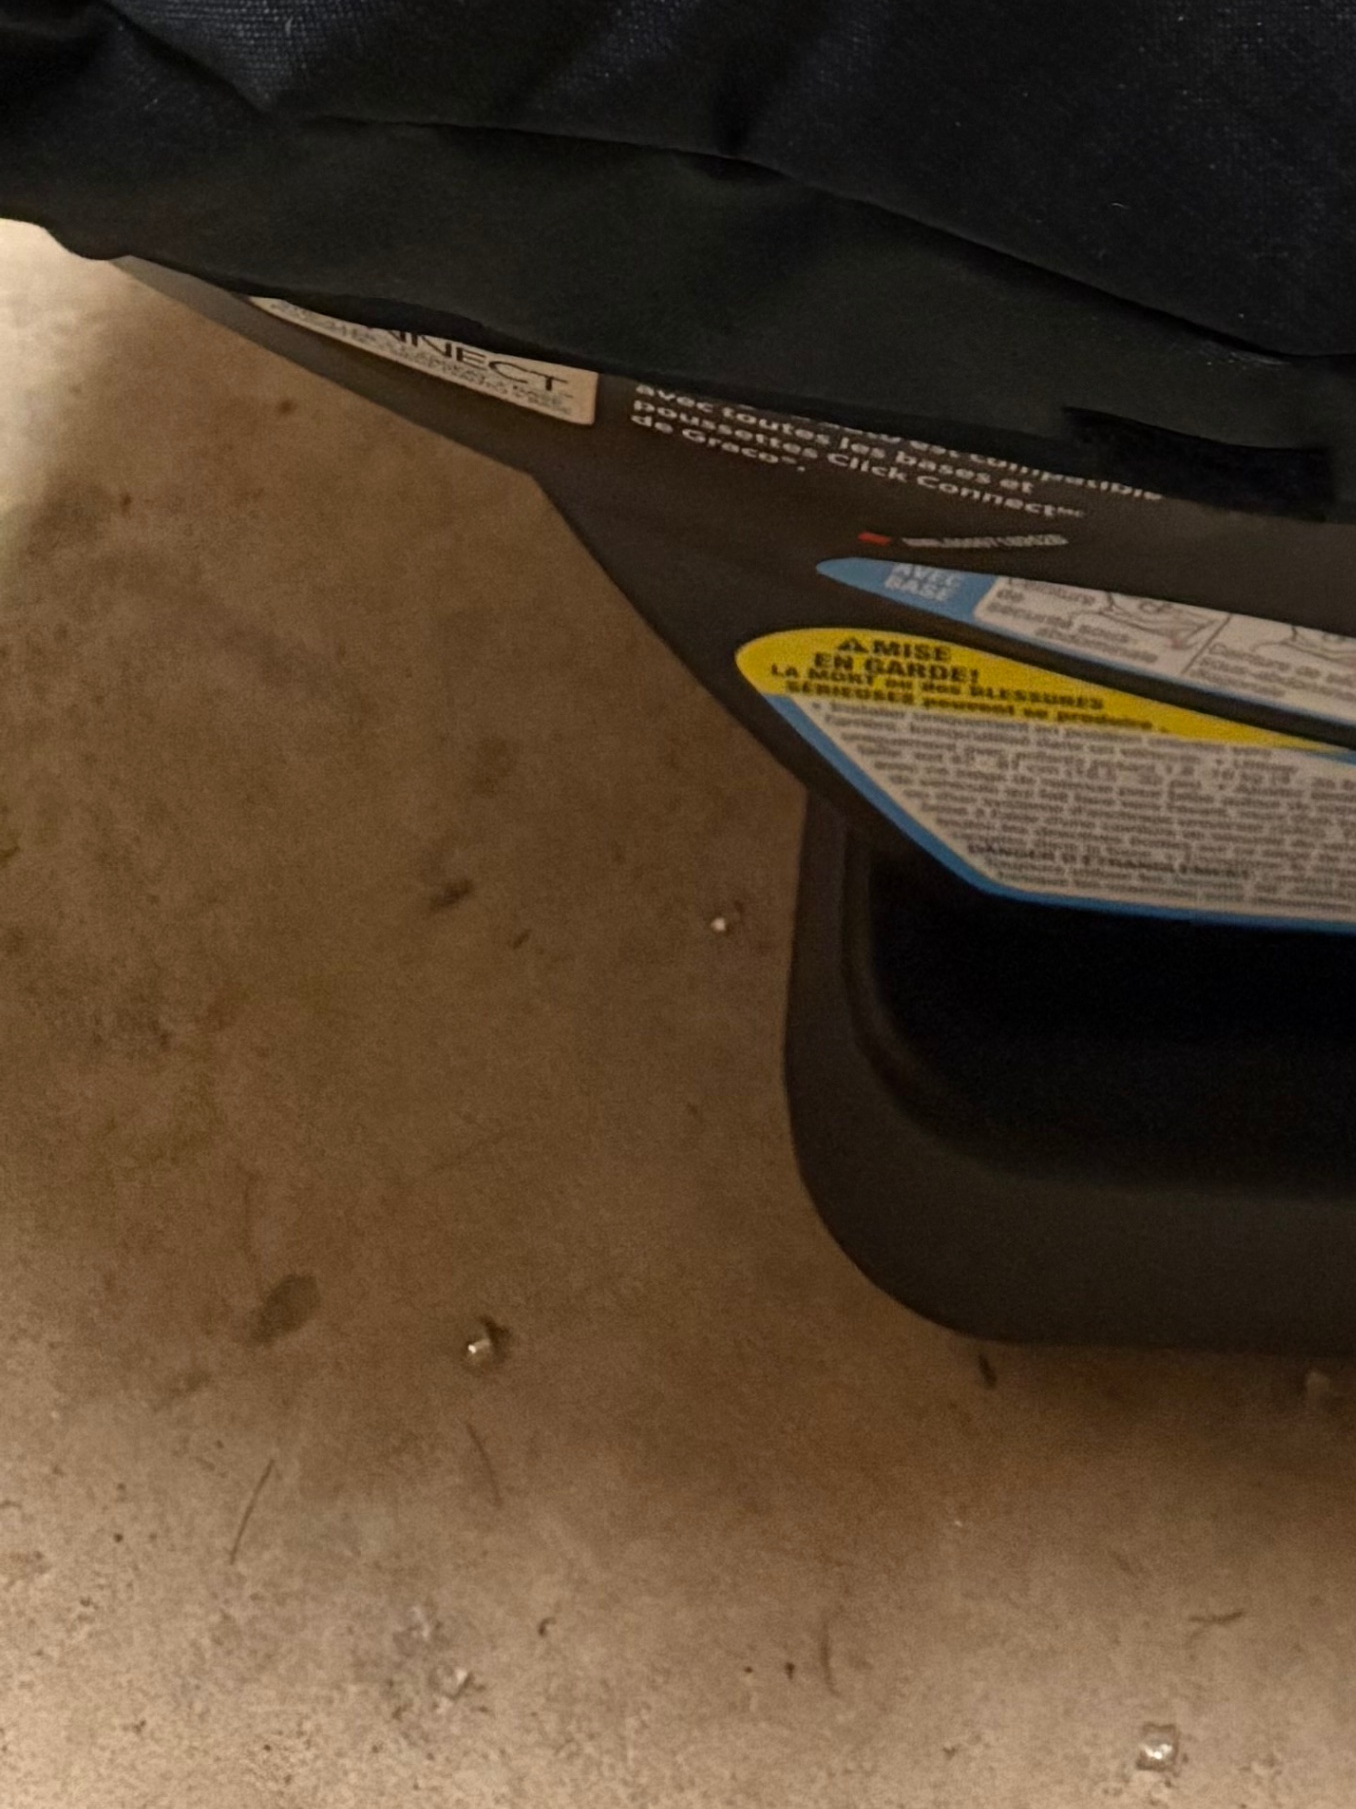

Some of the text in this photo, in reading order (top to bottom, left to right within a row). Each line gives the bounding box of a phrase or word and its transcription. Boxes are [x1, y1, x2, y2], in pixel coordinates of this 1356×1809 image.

[630, 414, 674, 434] de
[633, 399, 819, 459] poussettes
[826, 451, 908, 483] Click
[635, 383, 714, 414] avec
[721, 405, 831, 446] toutes
[839, 436, 887, 460] les
[895, 450, 992, 484] bases
[999, 478, 1035, 495] et
[814, 652, 980, 682] EN GARDE!
[873, 639, 952, 661] MISE
[771, 663, 801, 679] LA
[809, 667, 875, 688] MORT
[969, 684, 1105, 710] BLESSURES
